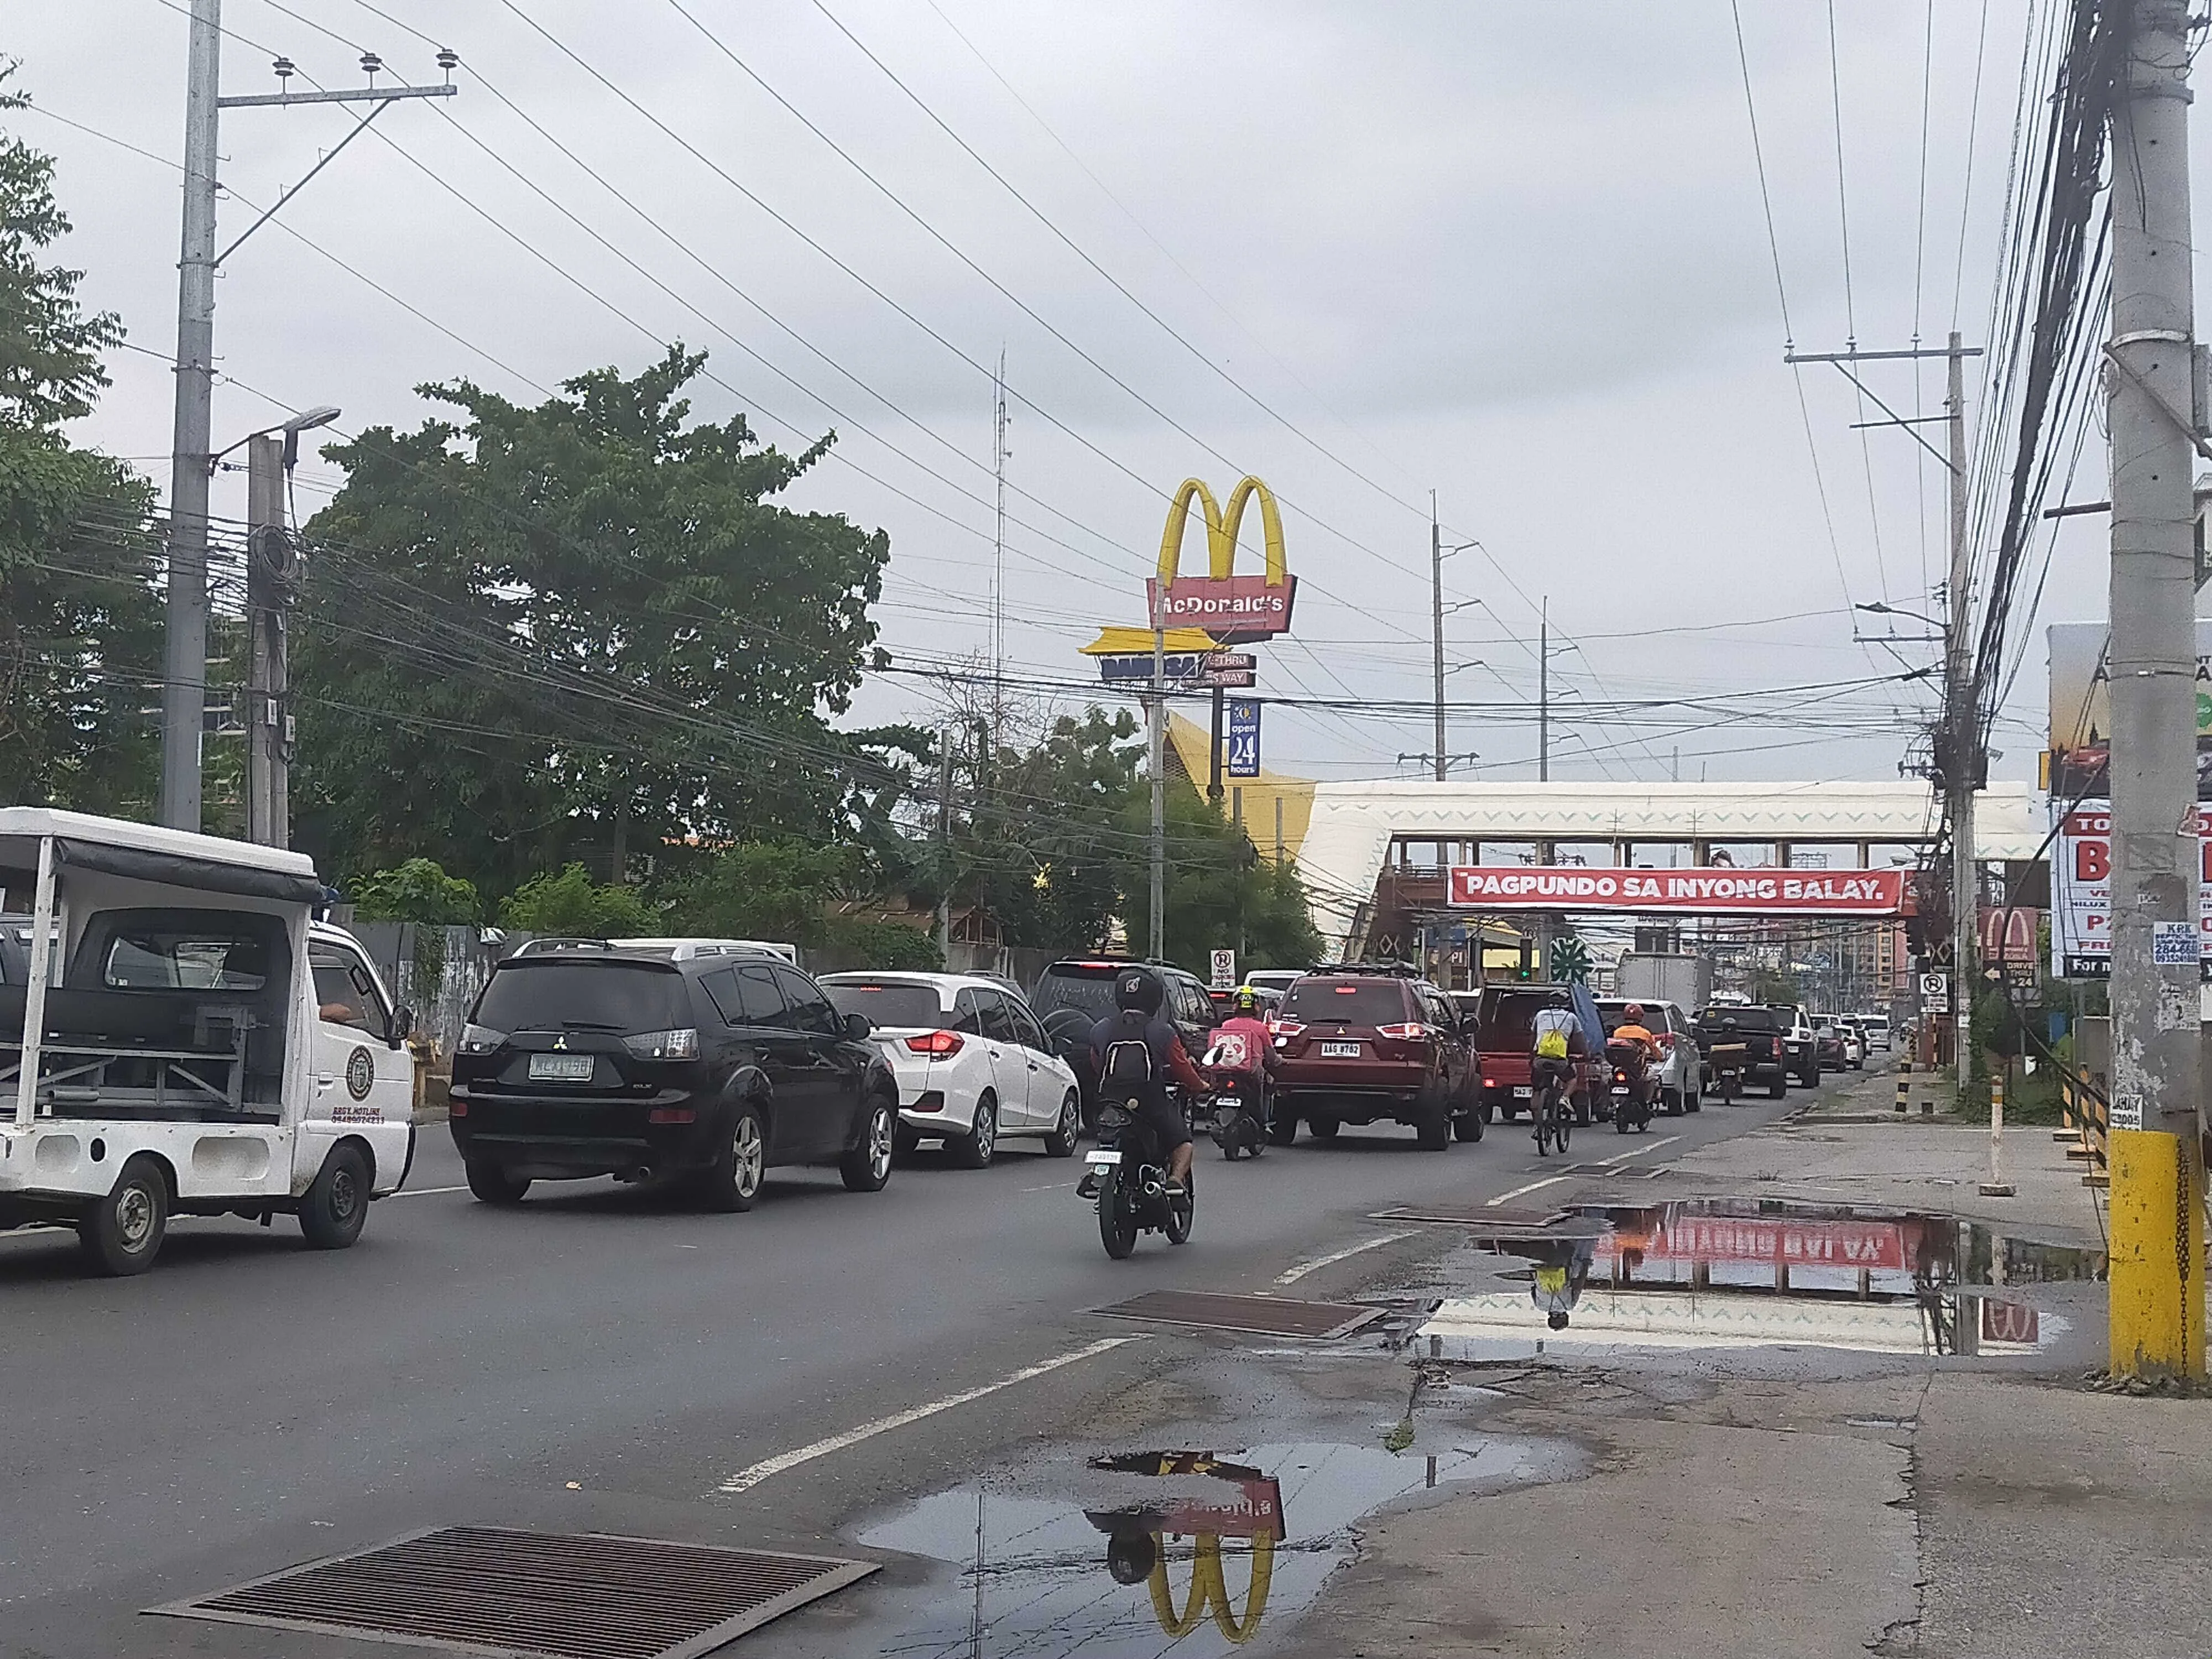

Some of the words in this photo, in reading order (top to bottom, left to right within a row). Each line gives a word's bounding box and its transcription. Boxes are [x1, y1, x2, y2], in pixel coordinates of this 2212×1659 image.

[1154, 595, 1284, 614] McDonald's
[1222, 674, 1244, 682] WAY
[1232, 725, 1256, 734] open
[1230, 735, 1255, 765] 24
[1230, 765, 1255, 774] hours
[1467, 875, 1617, 895] PAGPUNDO
[1623, 878, 1662, 898] SA
[1667, 878, 1776, 899] INYONG
[1783, 880, 1884, 900] BALAY.
[2073, 959, 2097, 972] For
